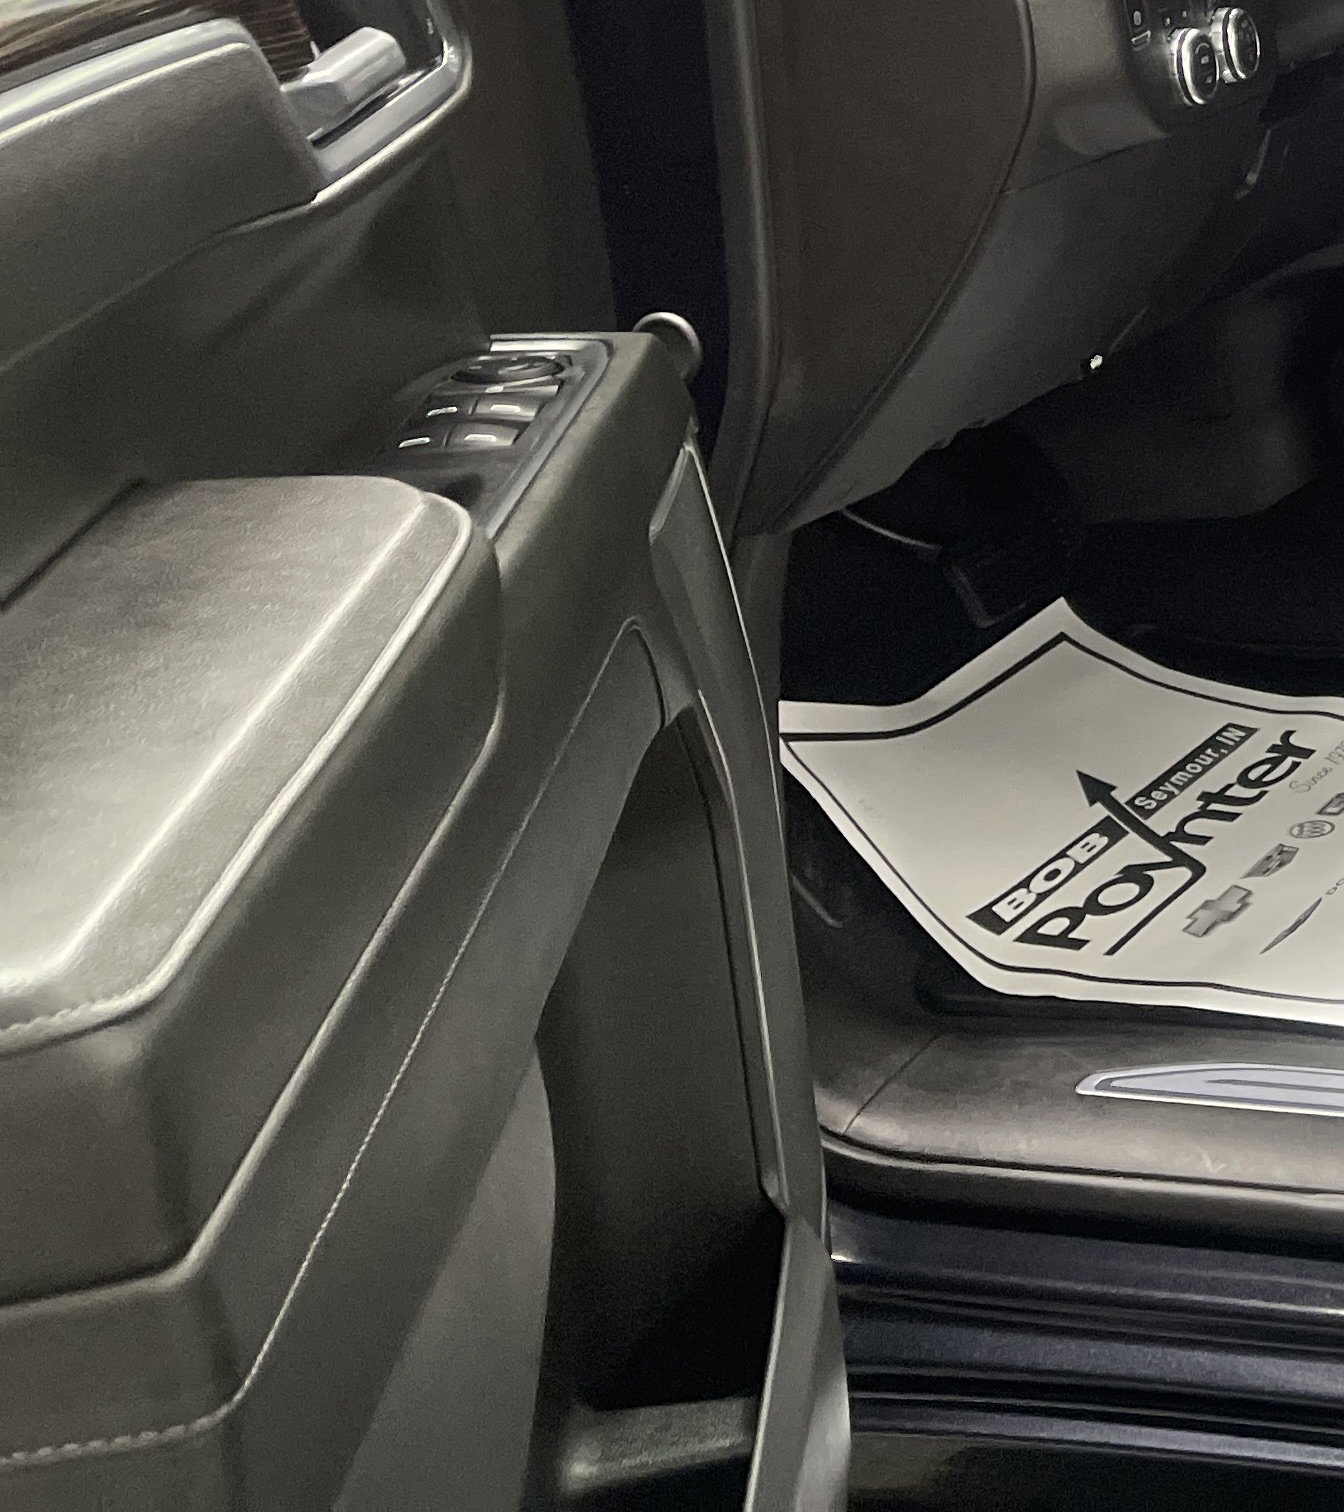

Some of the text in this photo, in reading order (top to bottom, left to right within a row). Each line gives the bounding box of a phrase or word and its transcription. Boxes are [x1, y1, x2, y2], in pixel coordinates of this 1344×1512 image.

[1134, 726, 1246, 811] Seymour, IN
[1289, 766, 1333, 793] Since
[991, 832, 1109, 923] BOB
[1013, 730, 1316, 956] Poynter
